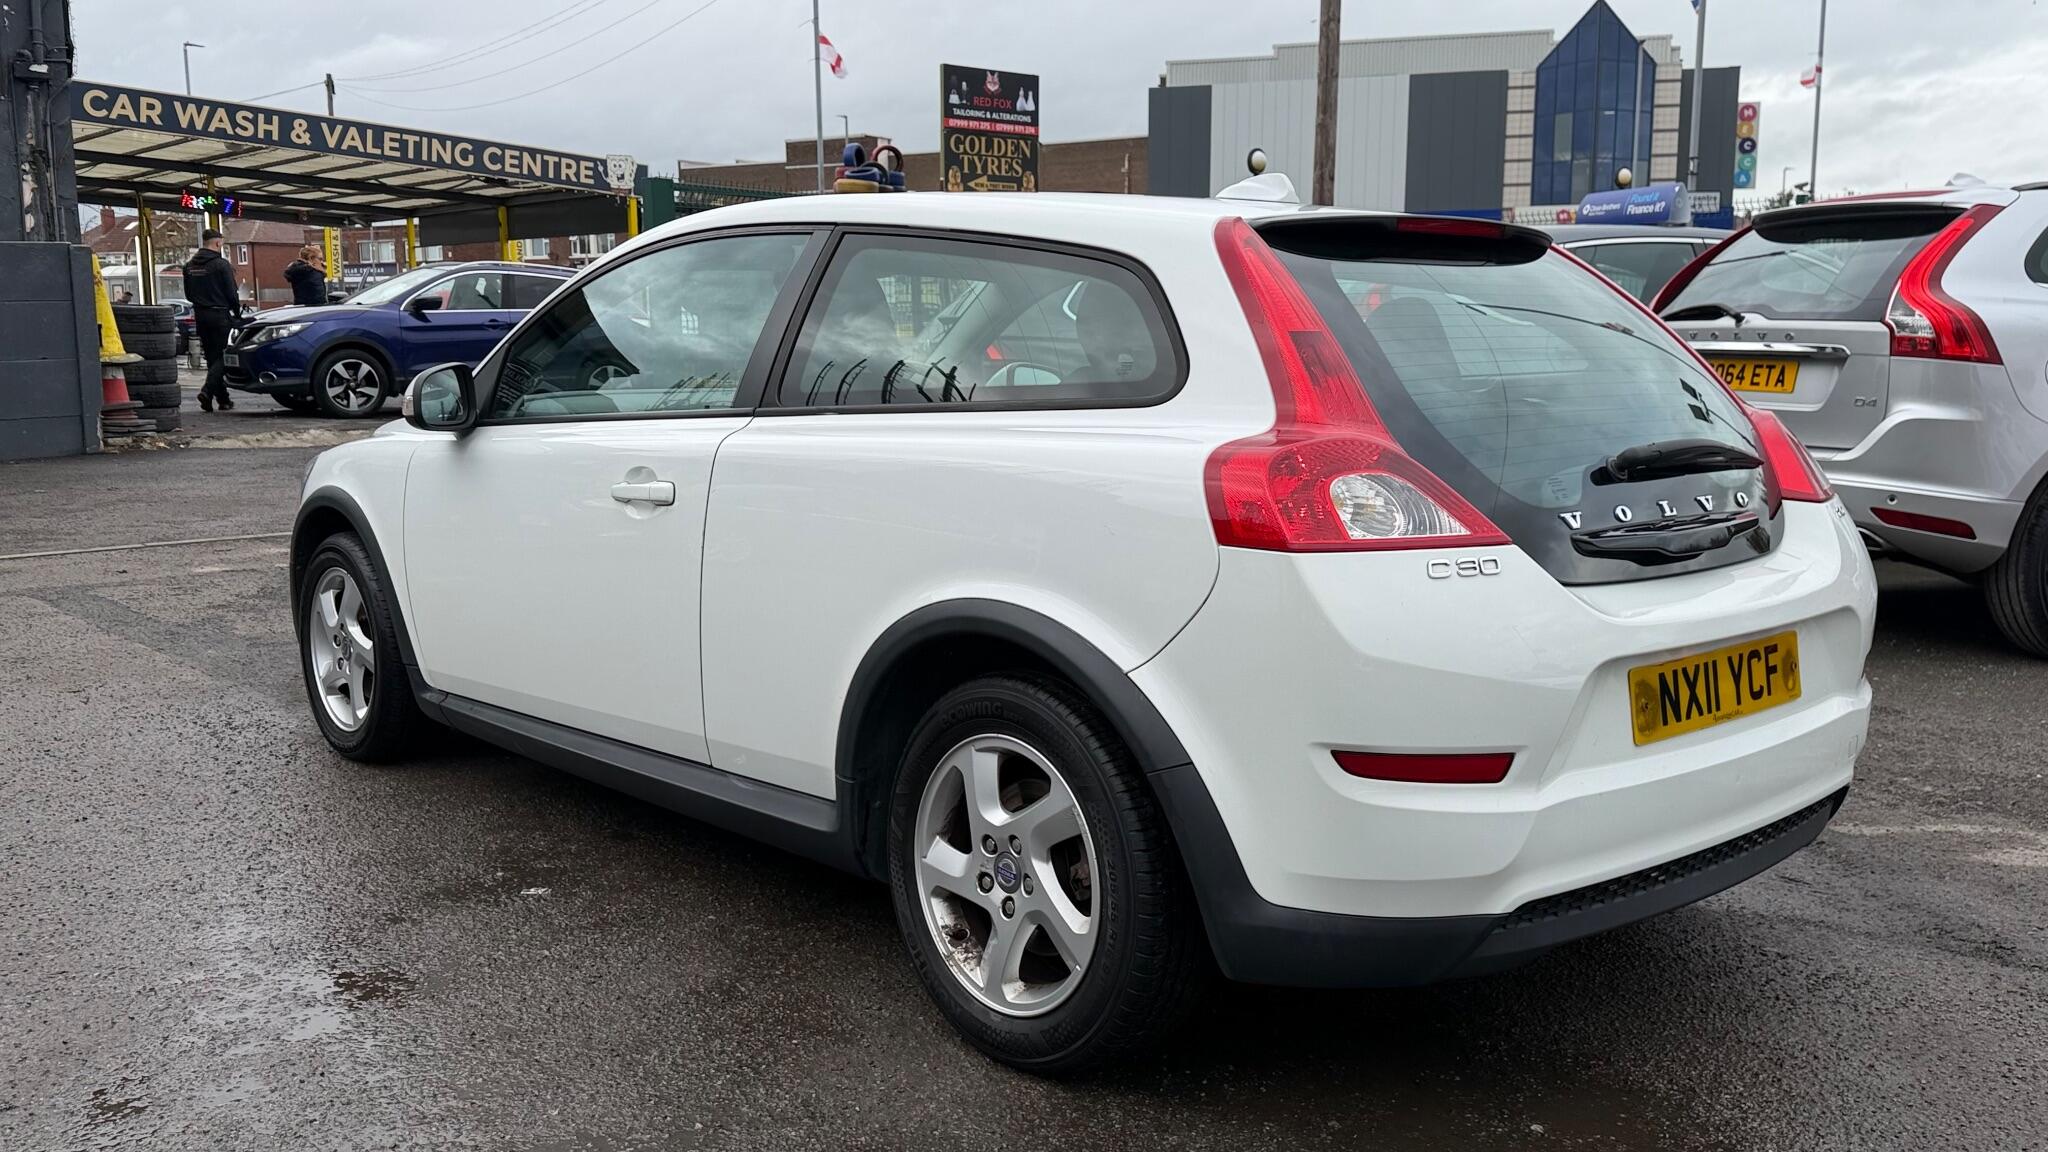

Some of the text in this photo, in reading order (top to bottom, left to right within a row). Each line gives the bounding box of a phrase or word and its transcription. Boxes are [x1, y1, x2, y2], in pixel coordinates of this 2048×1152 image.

[973, 96, 1012, 110] RED FOX
[953, 107, 985, 118] TAILORING
[992, 112, 1032, 123] ALTERATIONS
[82, 89, 595, 185] CAR WASH & VALETING CENTRE
[950, 132, 1032, 159] GOLDEN
[1737, 104, 1756, 185] MECCA
[959, 154, 1023, 177] TYRES
[1626, 203, 1654, 215] Finance
[1654, 201, 1665, 212] it?
[332, 244, 340, 274] WASH
[1688, 332, 1795, 342] VOLVO
[1749, 364, 1786, 387] ETA
[1853, 397, 1878, 408] D4
[1559, 491, 1750, 530] VOLVO
[1427, 555, 1501, 579] C30
[1658, 643, 1779, 727] NX11 YCF
